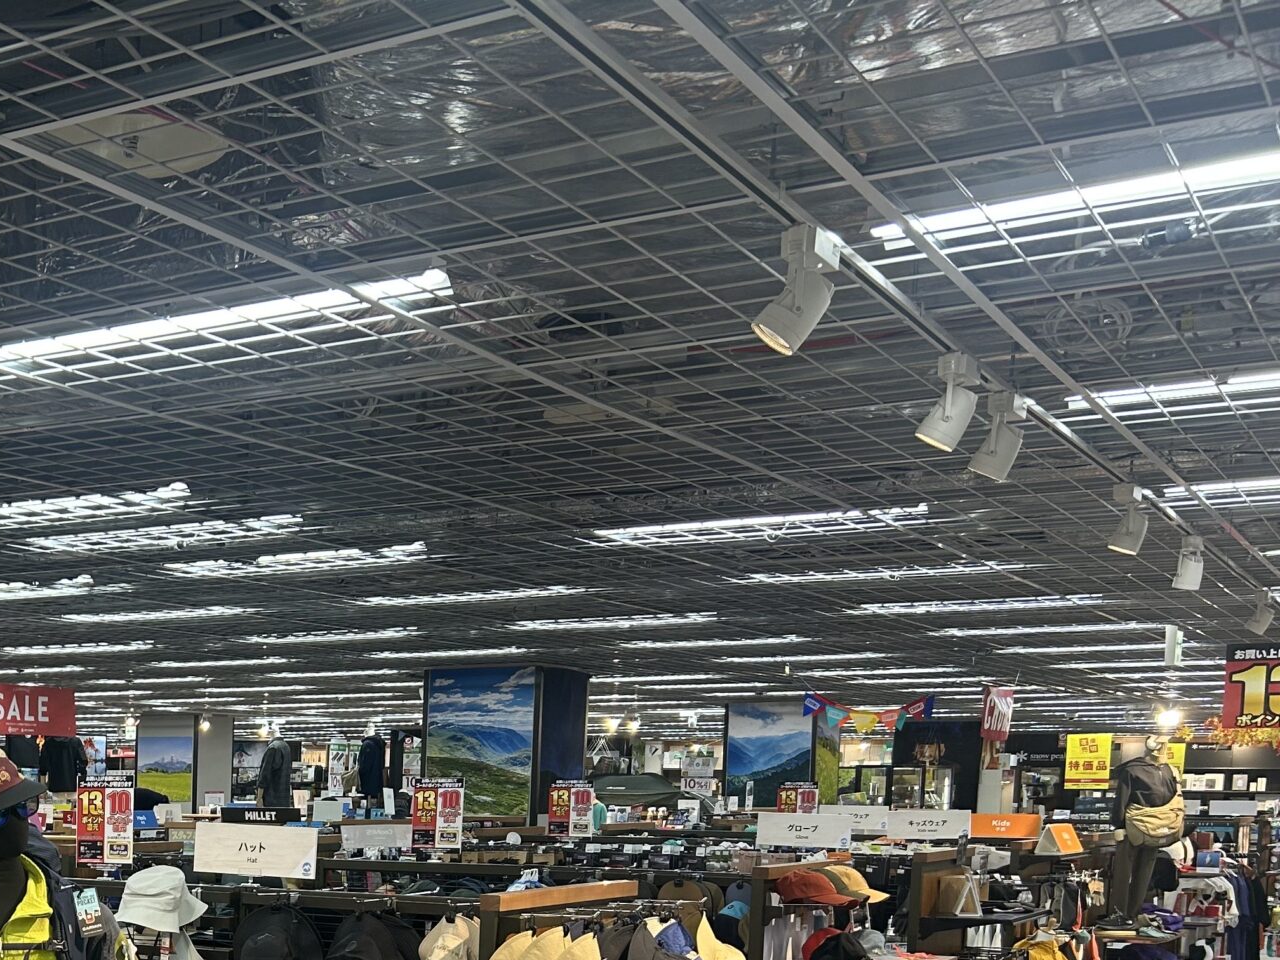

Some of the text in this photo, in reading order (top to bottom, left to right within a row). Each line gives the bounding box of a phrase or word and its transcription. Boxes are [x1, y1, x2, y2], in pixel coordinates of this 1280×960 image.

[1068, 760, 1107, 771] 特価品
[245, 811, 276, 821] MILLET
[787, 824, 818, 832] グローブ
[238, 841, 266, 854] ハット
[246, 856, 258, 864] Hat
